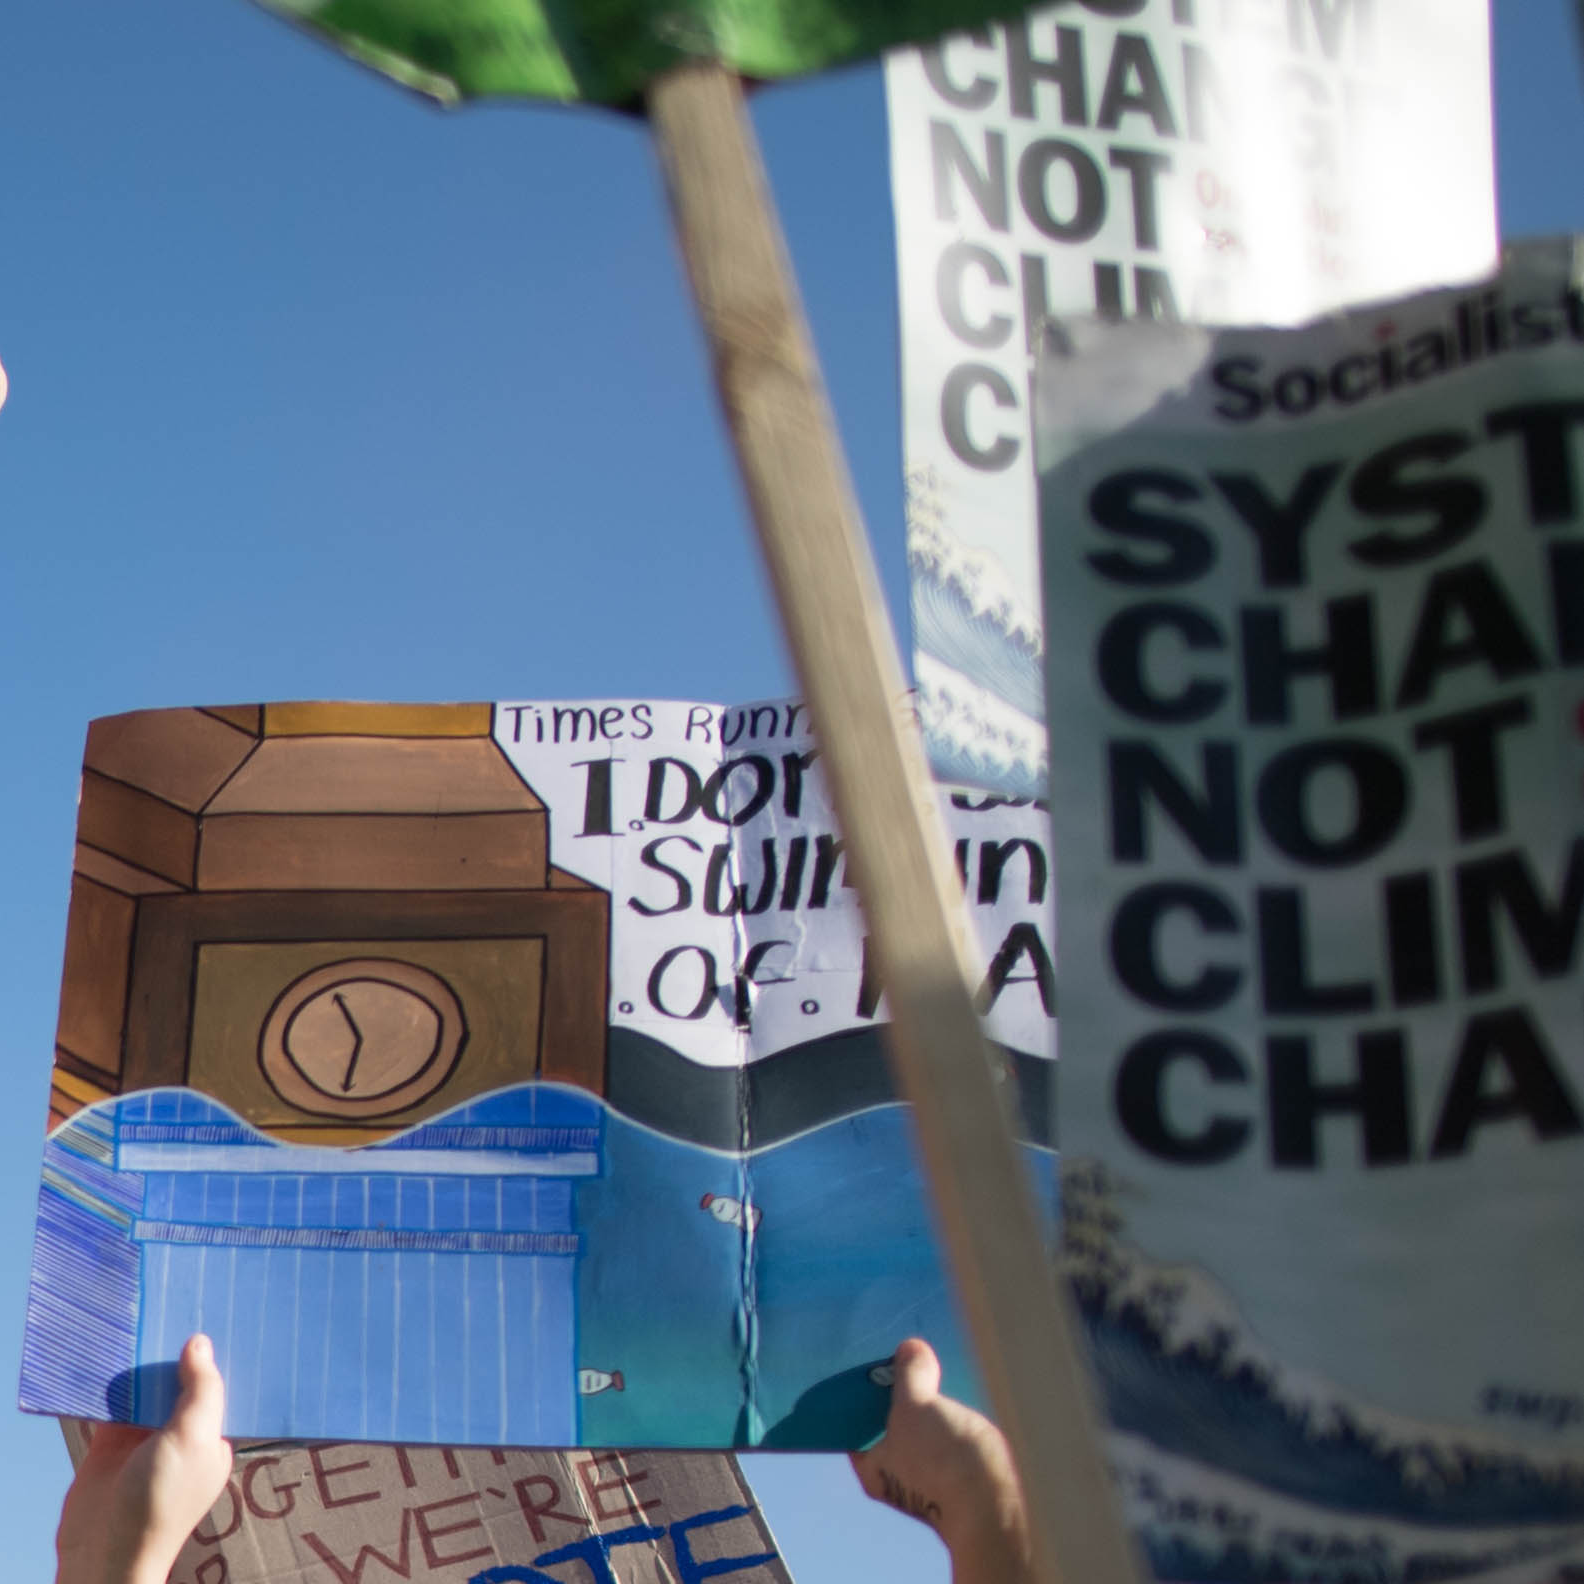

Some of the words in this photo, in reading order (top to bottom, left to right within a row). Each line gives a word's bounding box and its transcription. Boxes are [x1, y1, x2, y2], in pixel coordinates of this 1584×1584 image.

[928, 117, 1172, 253] NOT
[505, 704, 653, 743] Times
[1105, 692, 1533, 870] NOT
